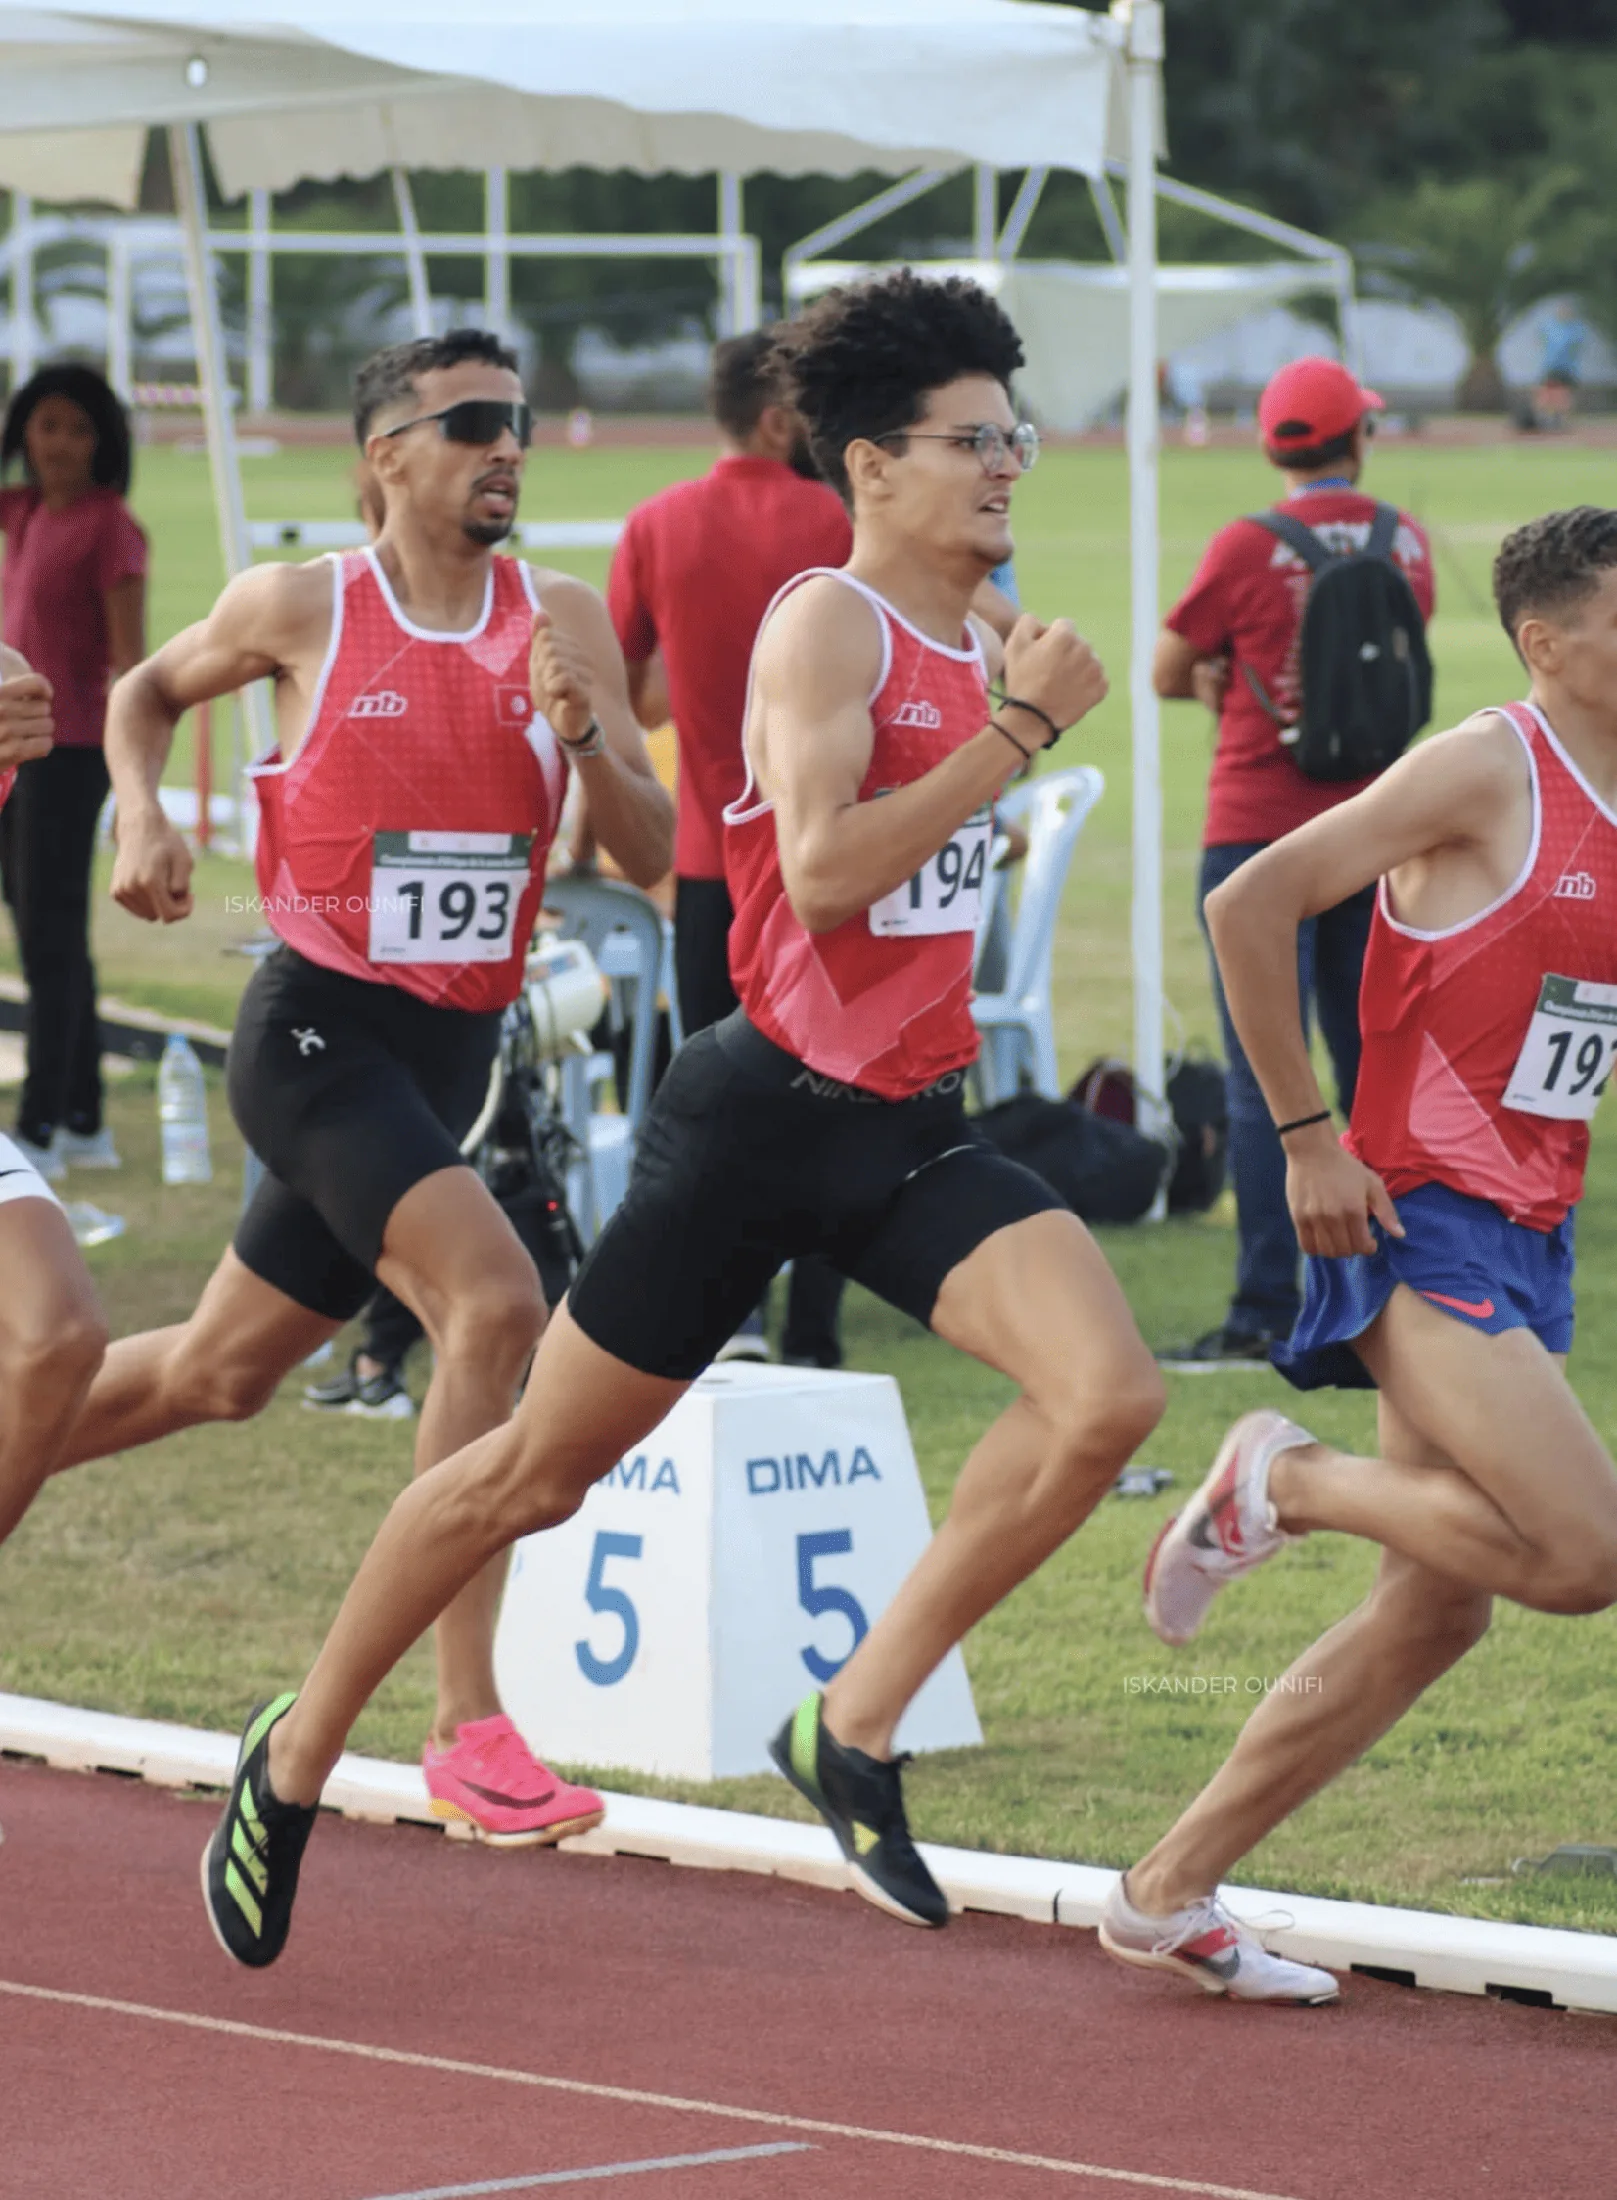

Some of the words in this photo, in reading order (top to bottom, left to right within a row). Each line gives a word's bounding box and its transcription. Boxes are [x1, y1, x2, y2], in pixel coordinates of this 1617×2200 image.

[397, 881, 511, 940] 193
[790, 1069, 882, 1103] NI
[599, 1455, 681, 1494] MA
[746, 1446, 882, 1495] DIMA
[575, 1529, 644, 1687] 5
[796, 1528, 870, 1684] 5
